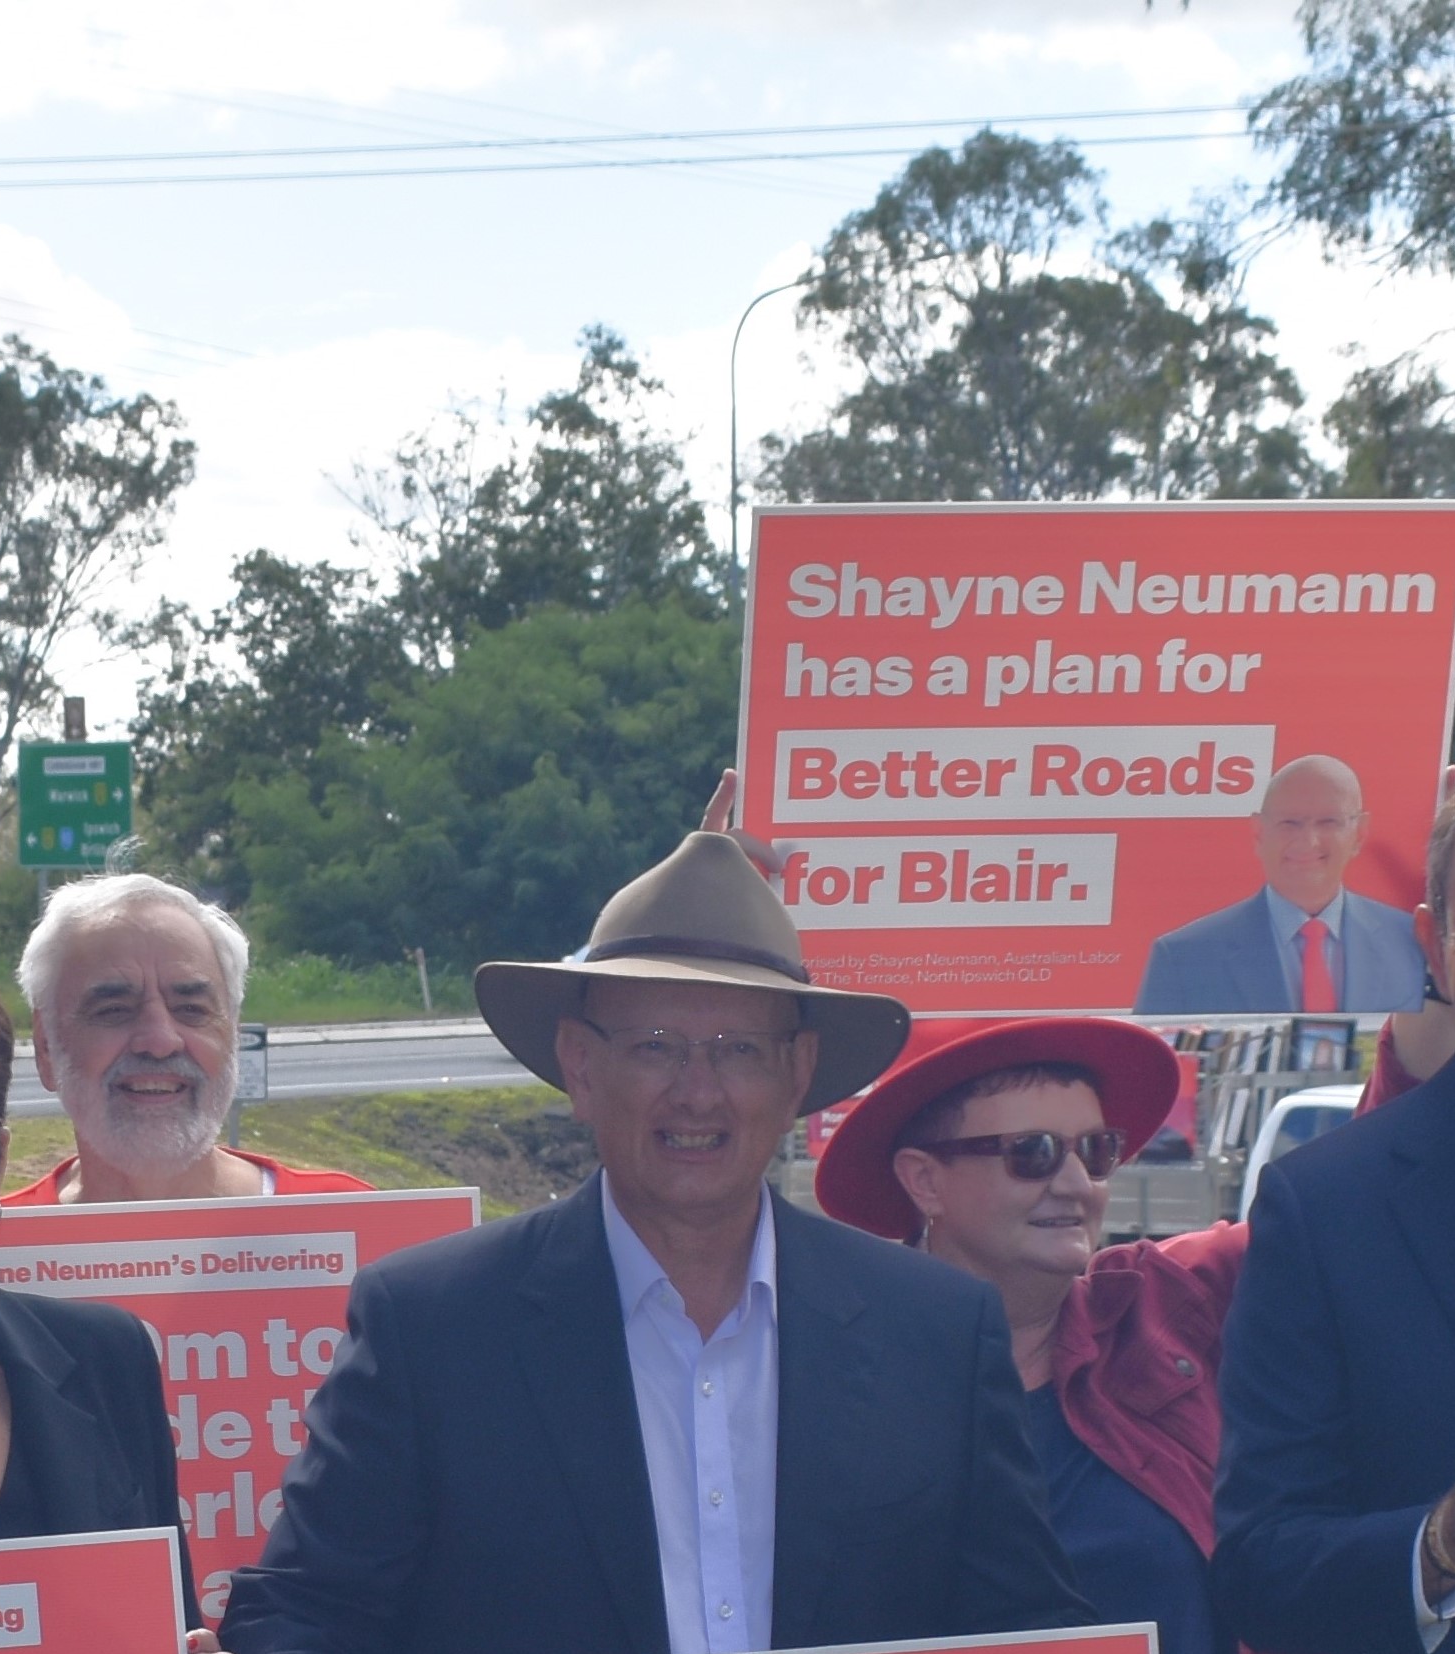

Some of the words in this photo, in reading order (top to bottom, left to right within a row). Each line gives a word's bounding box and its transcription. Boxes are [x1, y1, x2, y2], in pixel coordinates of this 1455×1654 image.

[788, 562, 1065, 629] Shayne
[1079, 560, 1436, 615] Neumann
[785, 642, 914, 698] has
[927, 655, 969, 696] a
[984, 639, 1142, 707] plan
[1156, 638, 1262, 694] for
[788, 747, 1017, 801] Better
[1030, 741, 1255, 797] Roads
[780, 851, 885, 906] for
[899, 848, 1088, 904] Blair.
[801, 955, 845, 968] orised
[201, 1249, 344, 1274] Delivering
[263, 1319, 344, 1377] to
